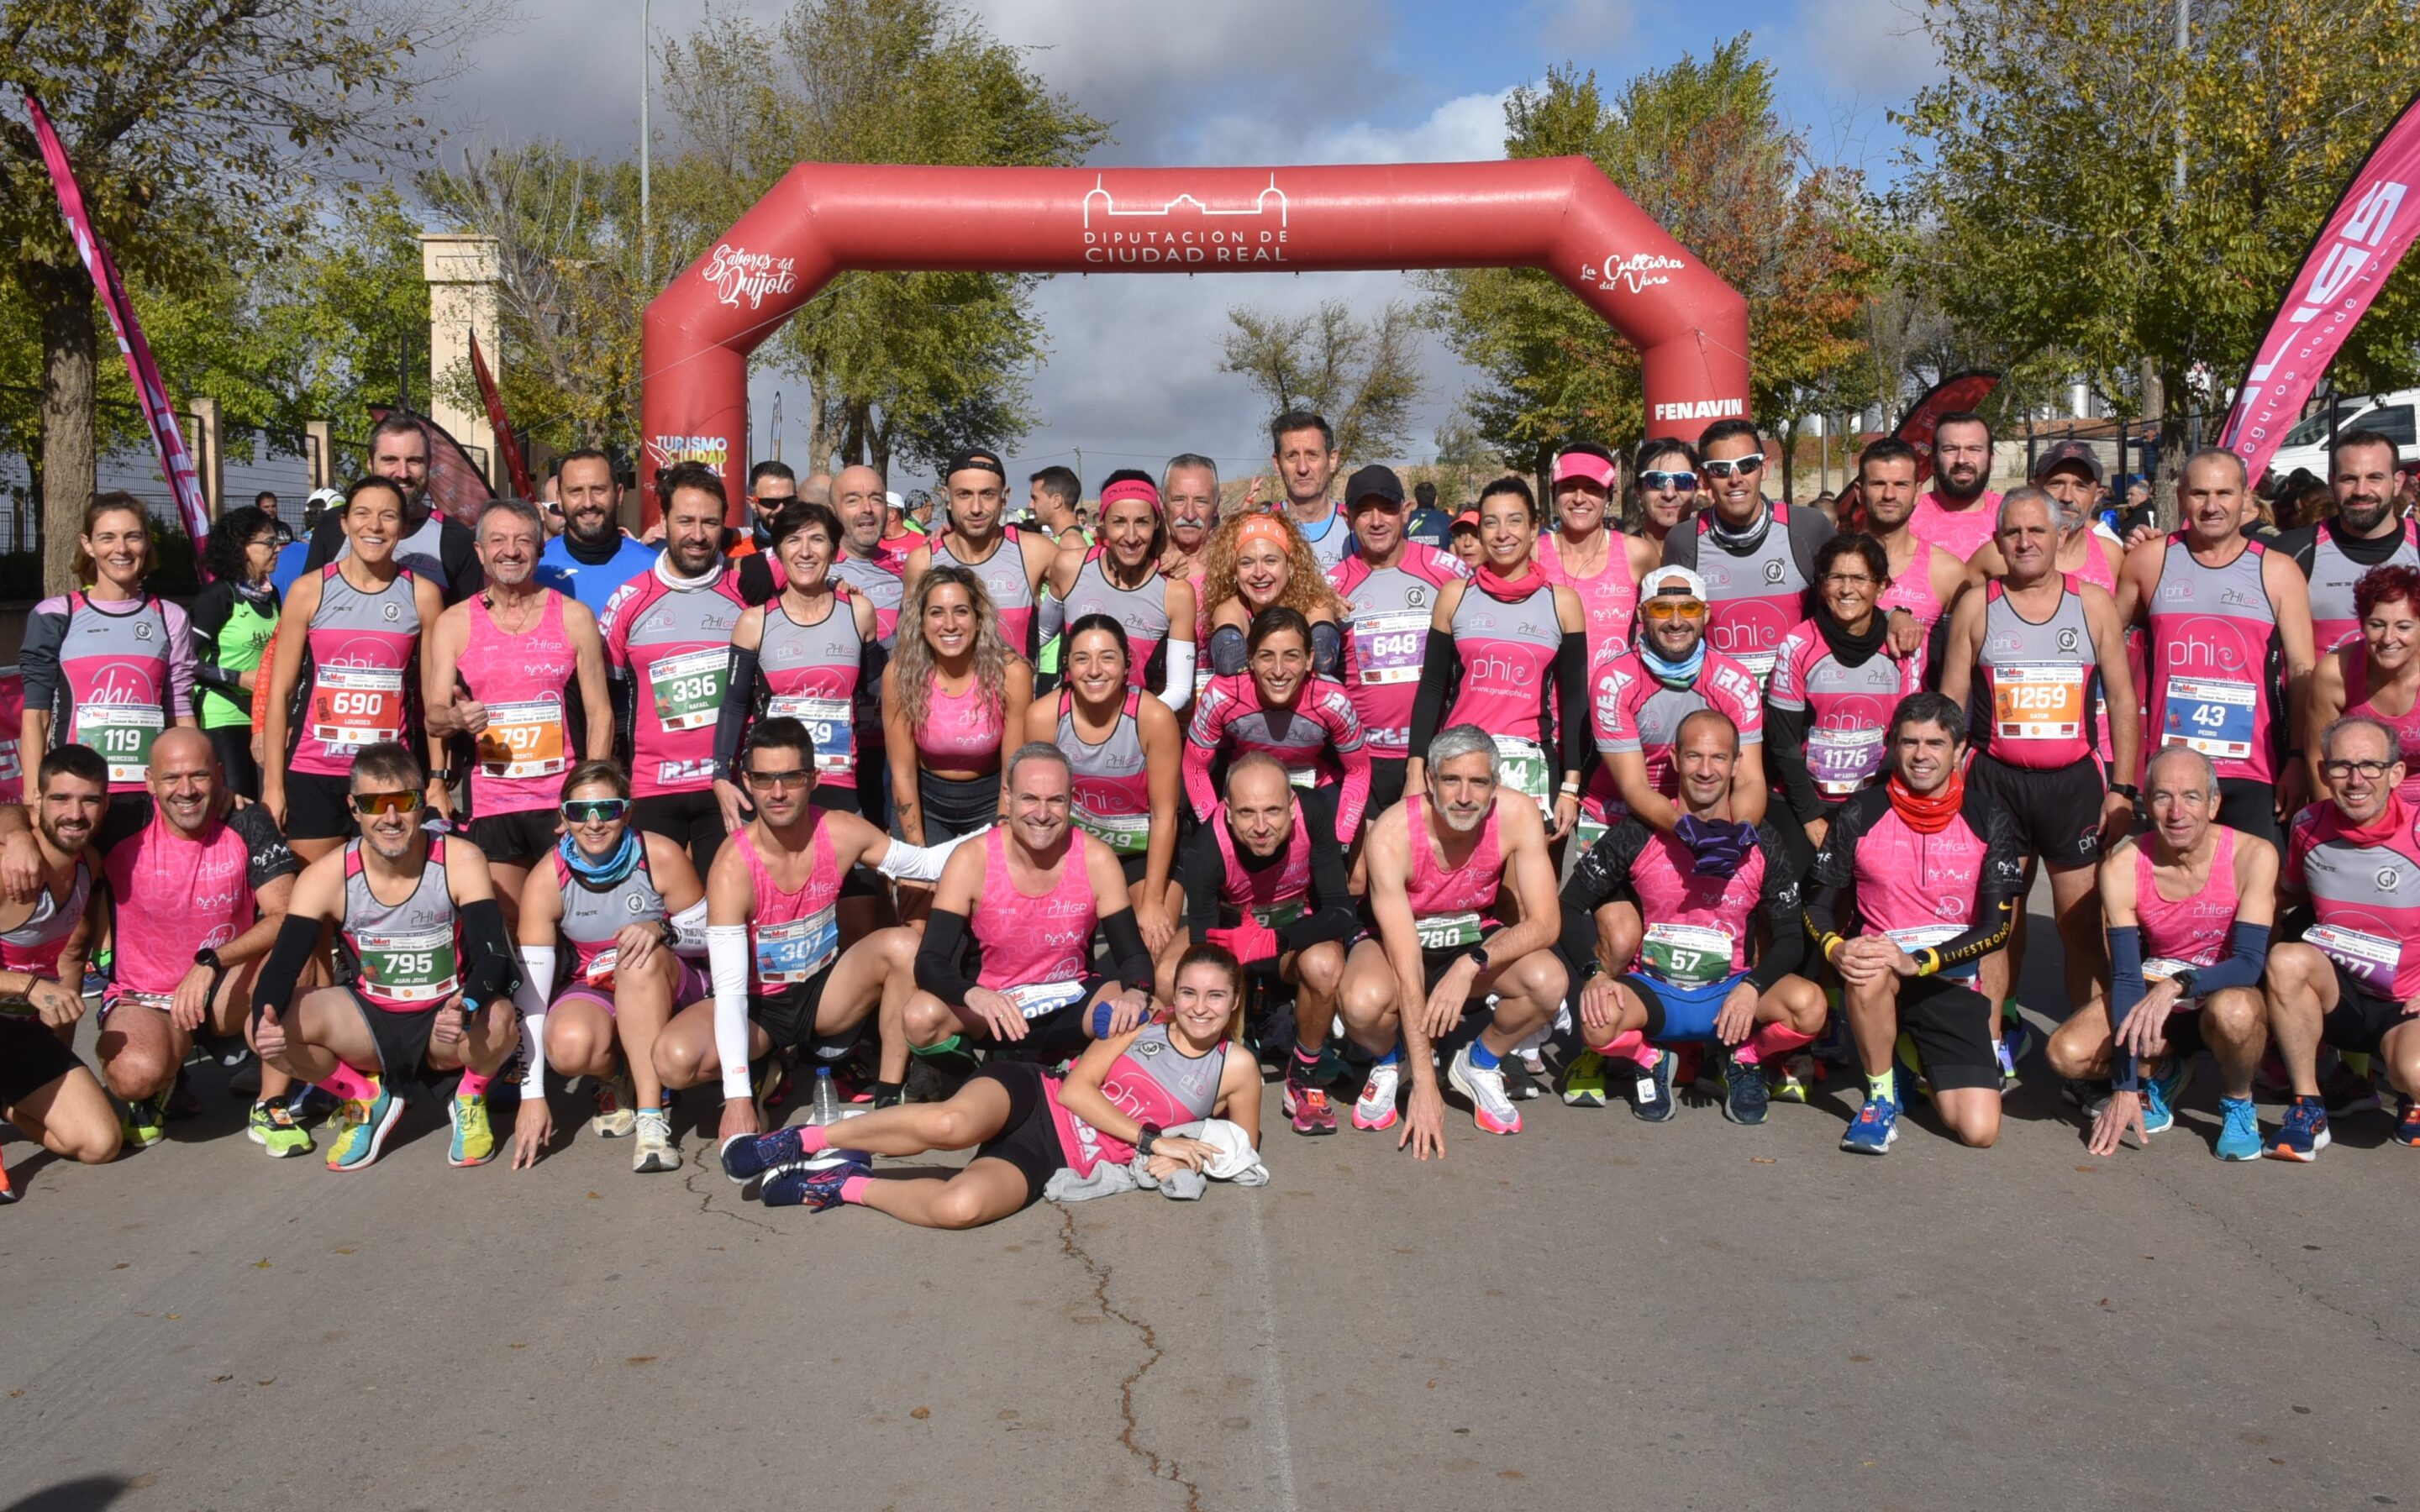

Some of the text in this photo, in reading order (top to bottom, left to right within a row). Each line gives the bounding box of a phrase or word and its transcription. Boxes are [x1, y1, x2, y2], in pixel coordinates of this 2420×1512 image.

[1084, 230, 1287, 244] DIPUTACIÓN DE
[702, 244, 795, 281] Sabores del
[1085, 247, 1288, 262] CIUDAD REAL
[1581, 253, 1685, 281] La Cultura
[718, 265, 797, 309] Quijote
[1599, 271, 1670, 294] del Vino
[2300, 298, 2358, 360] desde
[1655, 398, 1743, 421] FENAVIN
[655, 435, 728, 451] TURISMO
[668, 449, 728, 464] CIUDAD
[1372, 633, 1418, 657] 648
[1470, 654, 1512, 685] phi
[672, 674, 717, 702] 336
[2010, 685, 2067, 709] 1259
[333, 691, 383, 716] 690
[689, 701, 709, 710] RAFAEL
[2191, 704, 2226, 727] 43
[104, 728, 141, 752] 119
[499, 725, 542, 749] 797
[1823, 747, 1869, 769] 1176
[780, 932, 822, 962] 307
[1944, 921, 2010, 963] LIVESTRONG
[383, 953, 433, 974] 795
[1670, 949, 1702, 972] 57
[411, 975, 429, 984] JOSÉ
